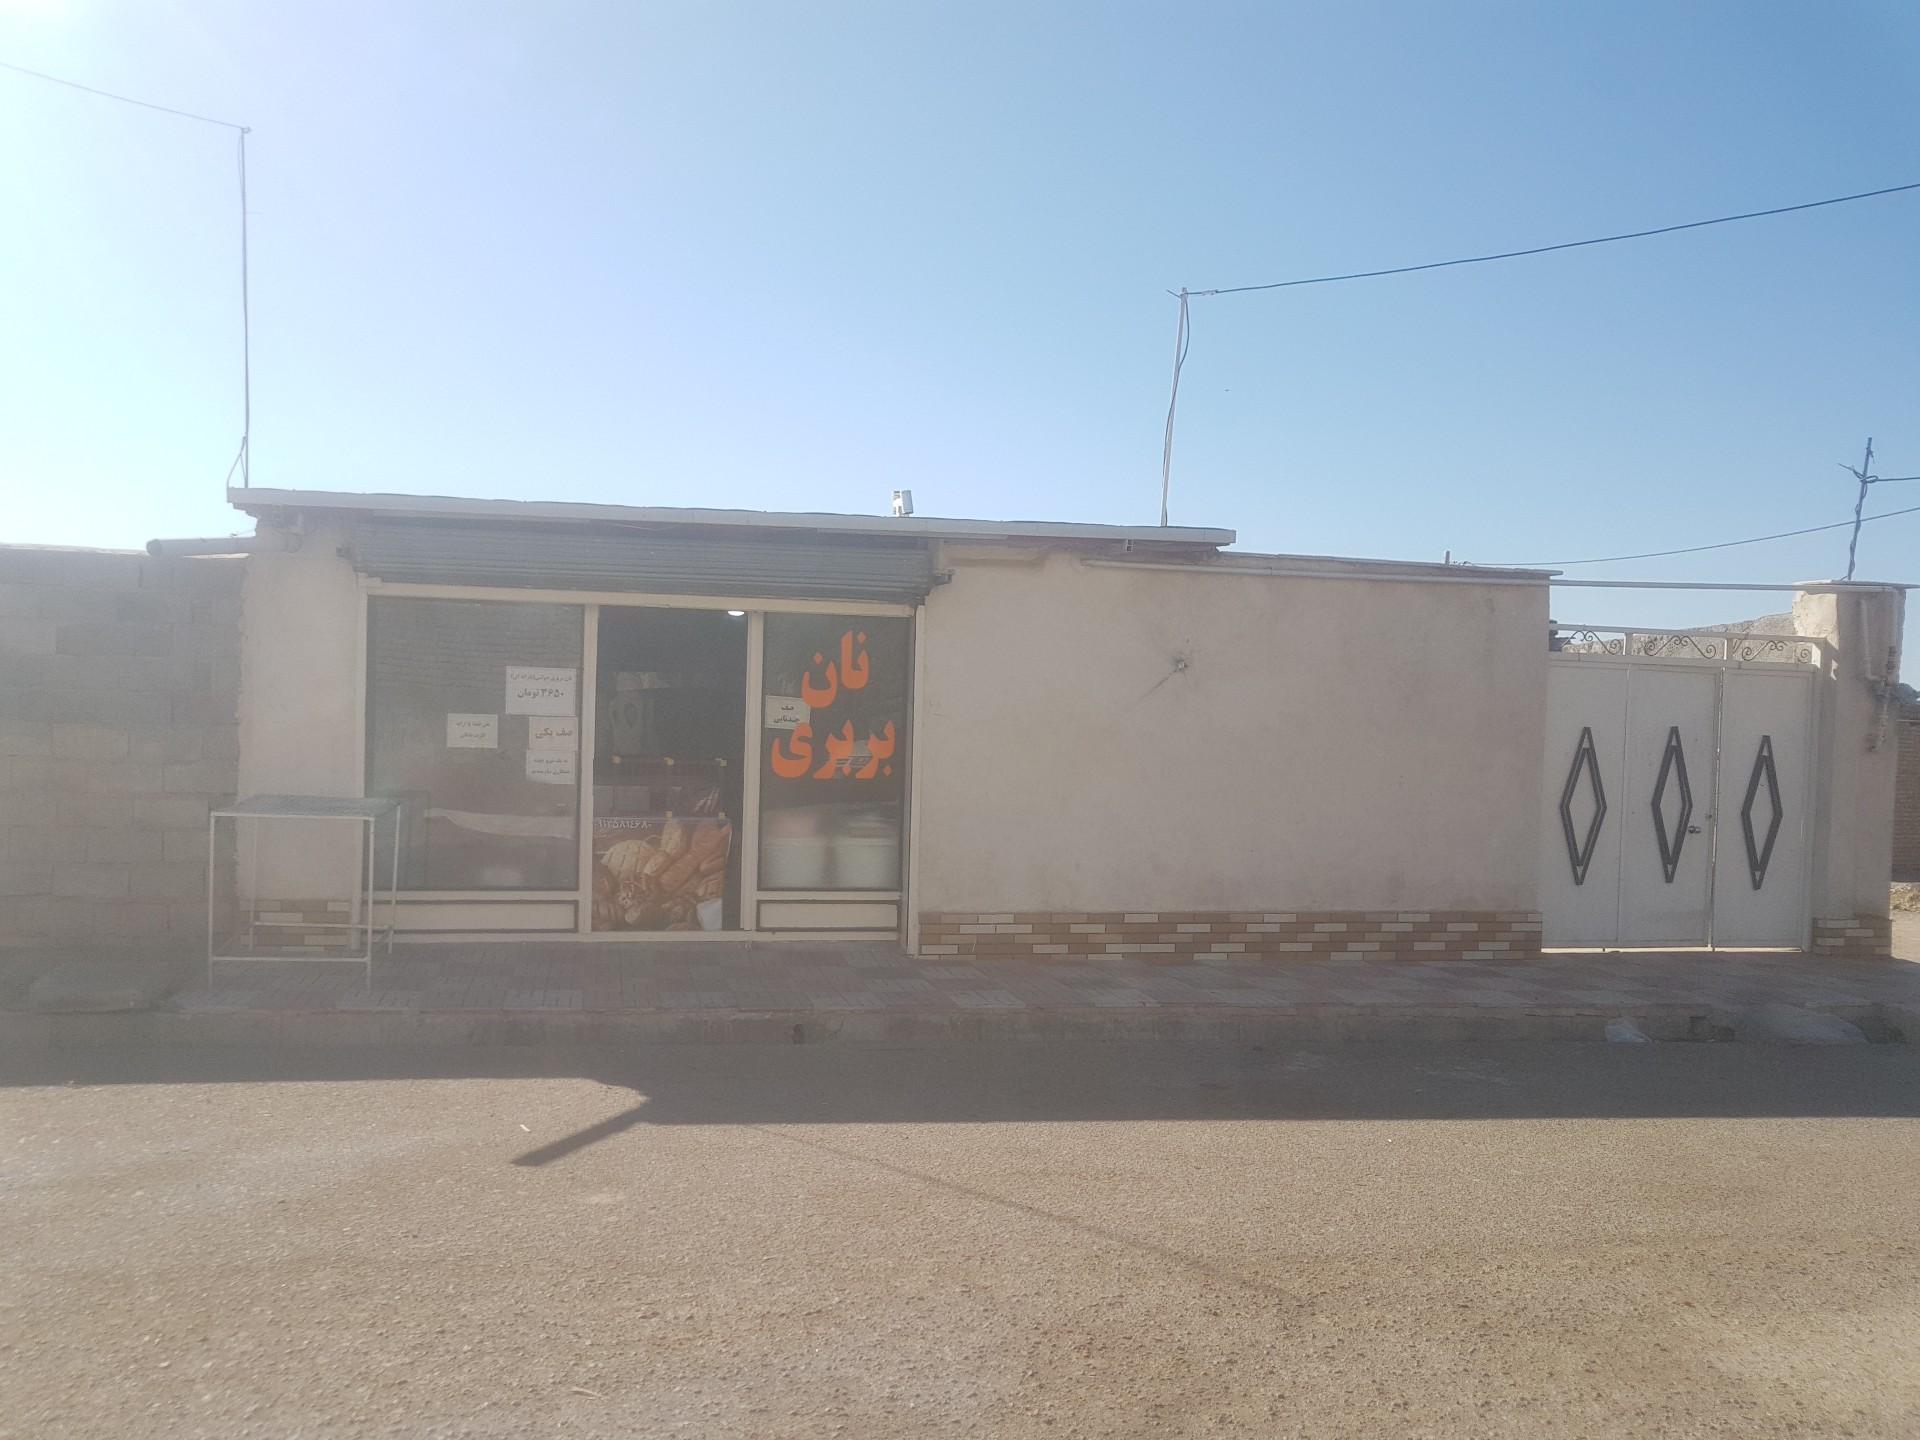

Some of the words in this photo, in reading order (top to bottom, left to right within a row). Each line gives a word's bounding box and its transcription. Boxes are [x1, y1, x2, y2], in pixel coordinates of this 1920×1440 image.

[516, 687, 540, 700] تومان
[801, 628, 870, 709] نان
[771, 720, 897, 780] بربری
